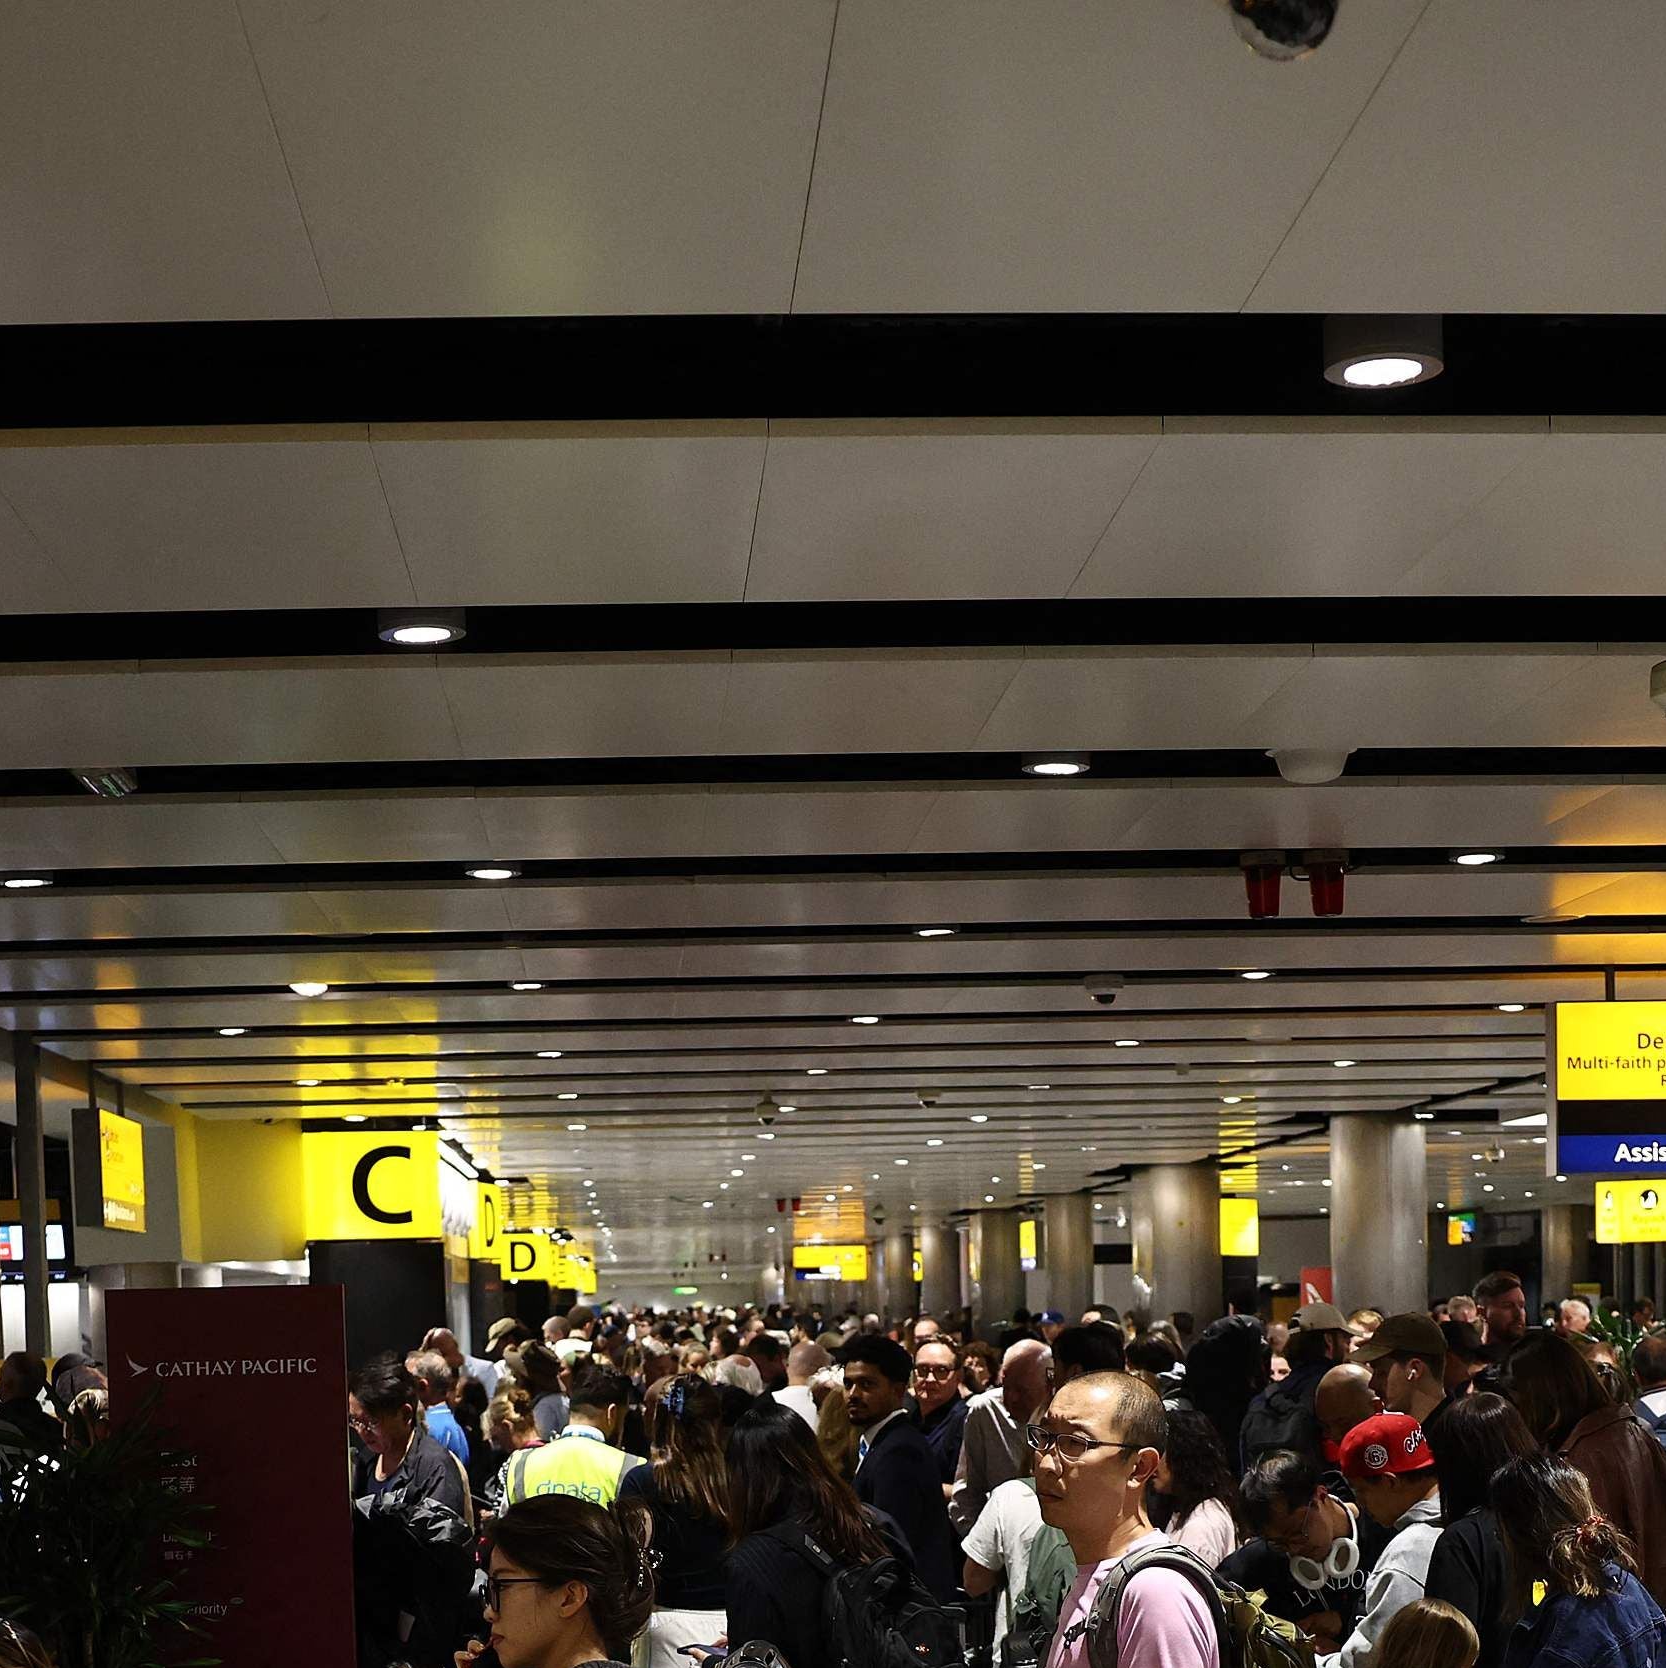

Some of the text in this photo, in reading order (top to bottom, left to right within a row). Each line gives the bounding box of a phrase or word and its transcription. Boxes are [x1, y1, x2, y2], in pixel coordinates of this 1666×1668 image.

[1568, 1057, 1652, 1070] Multi-faith
[352, 1145, 413, 1224] C
[484, 1194, 495, 1247] D
[510, 1241, 536, 1273] D
[155, 1357, 317, 1377] CATHAY PACIFIC
